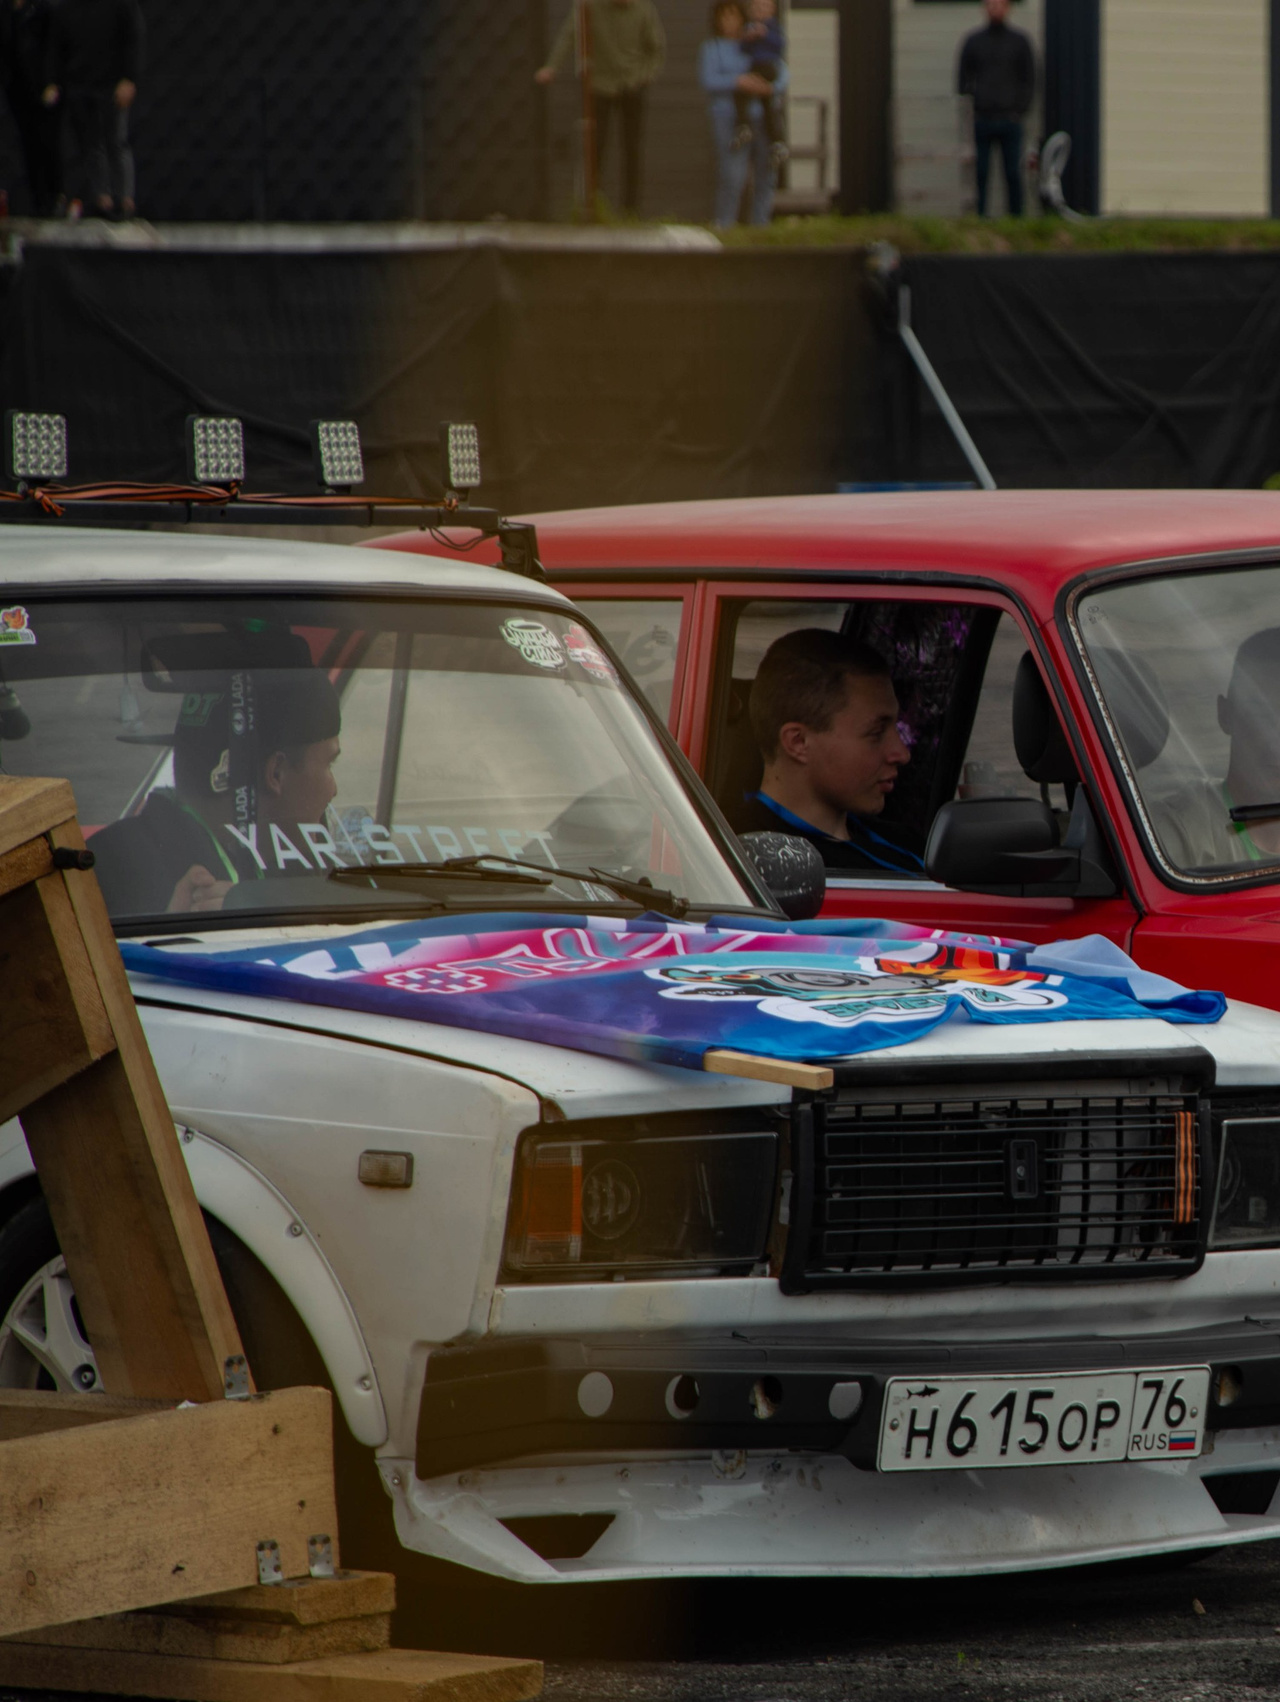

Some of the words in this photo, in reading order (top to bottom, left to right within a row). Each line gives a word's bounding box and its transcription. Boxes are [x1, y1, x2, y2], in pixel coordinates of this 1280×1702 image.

[232, 673, 244, 707] LADA
[236, 786, 248, 820] LADA
[224, 823, 348, 870] YAR
[362, 823, 559, 873] STREET
[1141, 1377, 1188, 1430] 76
[1130, 1432, 1168, 1452] RUS
